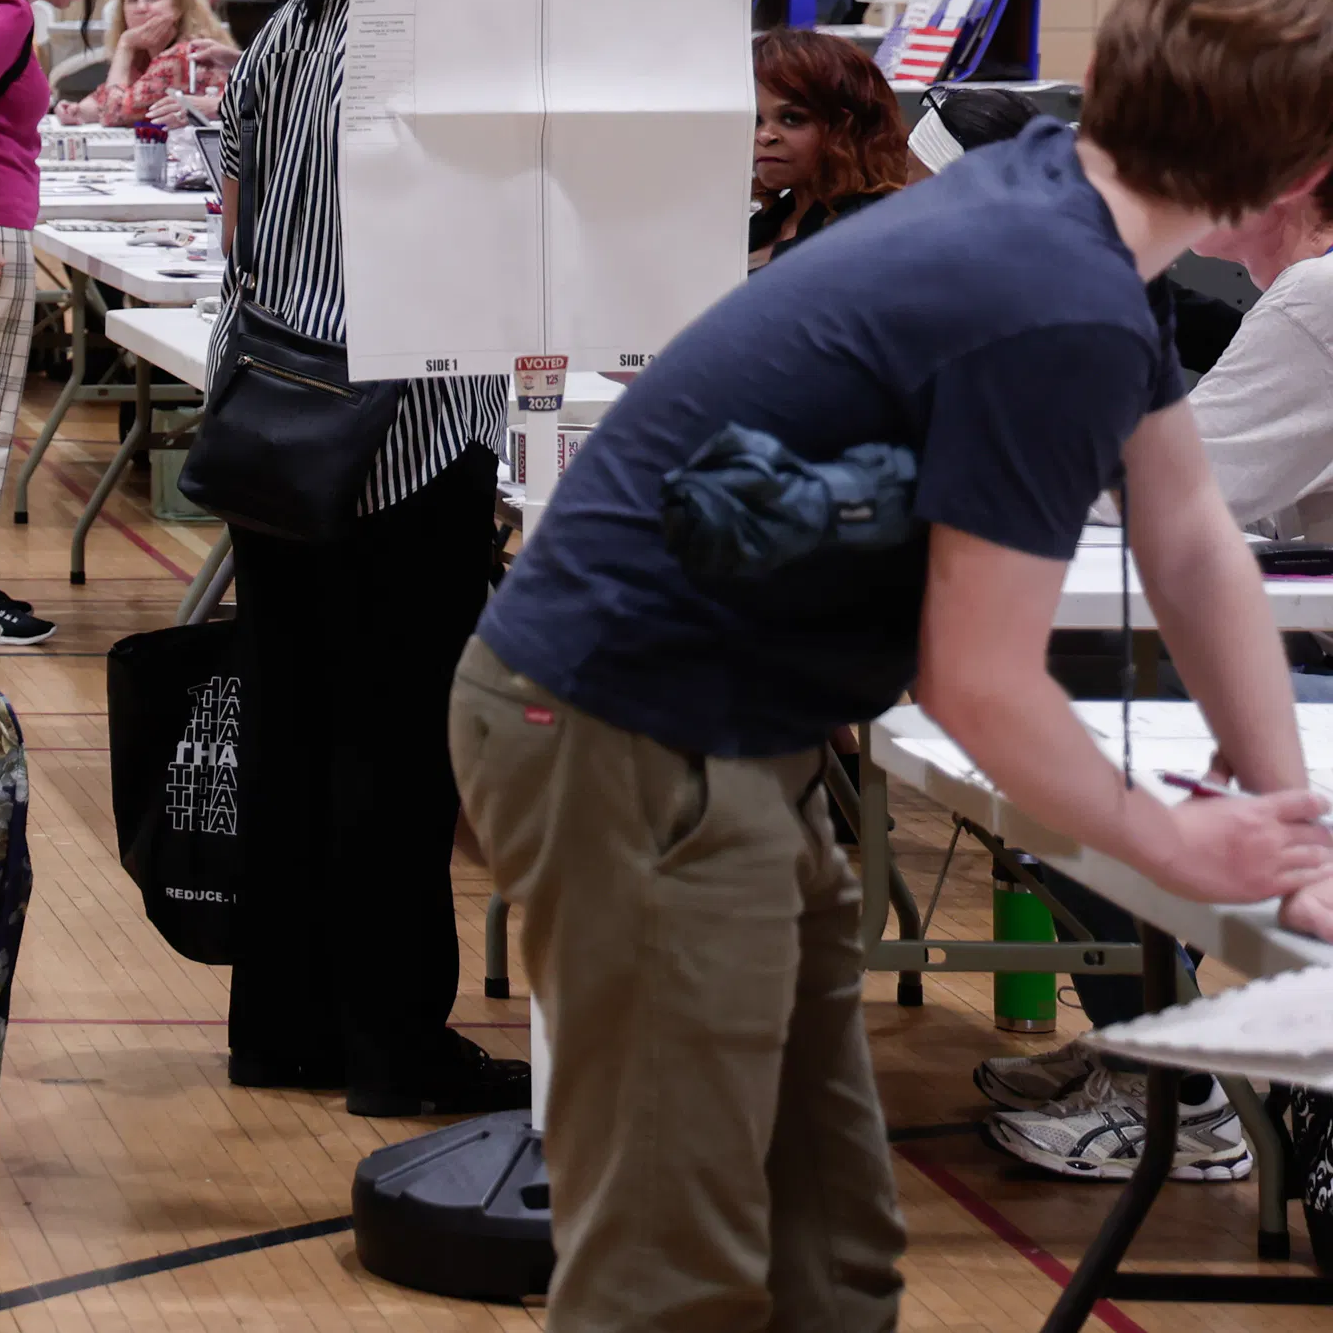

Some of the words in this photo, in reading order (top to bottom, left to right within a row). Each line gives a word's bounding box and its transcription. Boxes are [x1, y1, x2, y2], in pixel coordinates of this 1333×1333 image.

[426, 359, 451, 372] SIDE
[453, 359, 458, 371] 1
[517, 358, 522, 370] I
[524, 356, 565, 369] VOTED
[619, 353, 645, 367] SIDE
[528, 396, 558, 409] 2026
